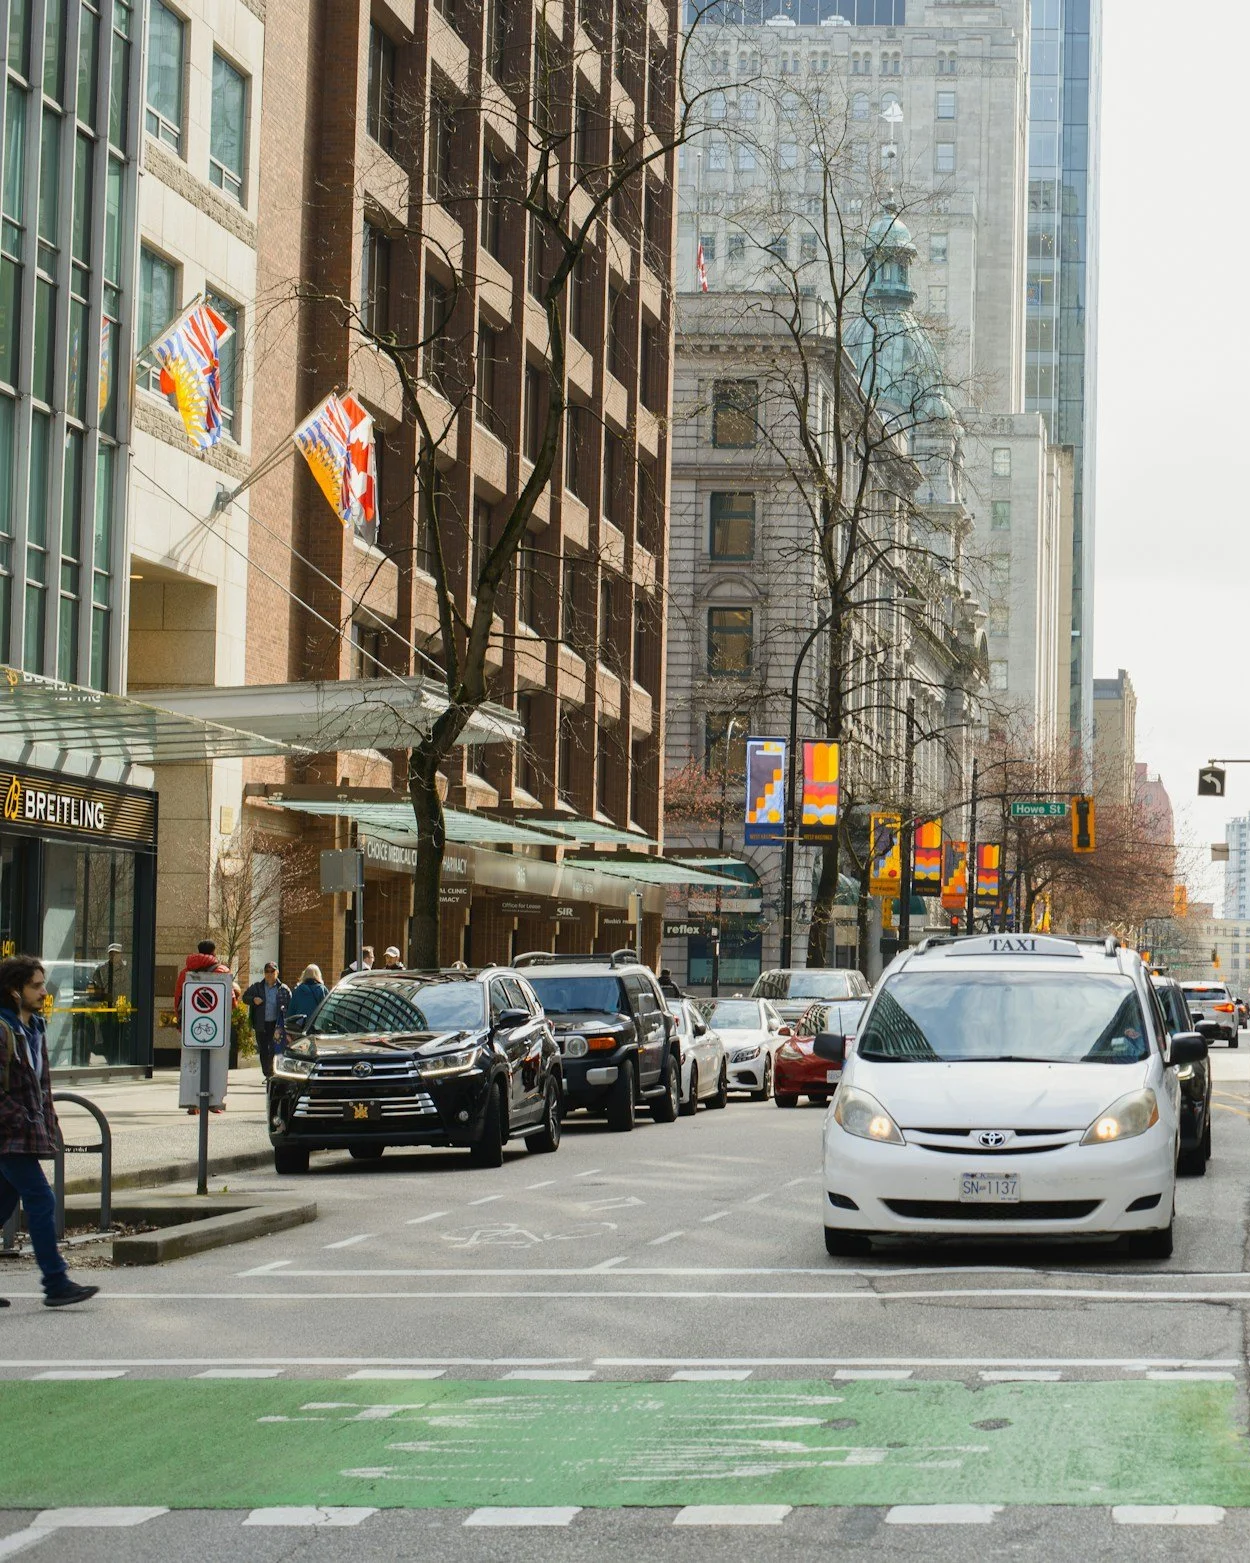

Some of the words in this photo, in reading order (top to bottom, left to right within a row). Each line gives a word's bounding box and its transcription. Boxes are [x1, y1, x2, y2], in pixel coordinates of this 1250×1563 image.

[24, 789, 105, 830] BREITLING
[1016, 804, 1045, 814] Howe
[1049, 804, 1061, 814] St
[367, 841, 388, 861] CHOICE
[388, 845, 412, 866] MEDICAL
[556, 907, 573, 917] SIR
[667, 924, 700, 935] reflex
[989, 938, 1038, 951] TAXI
